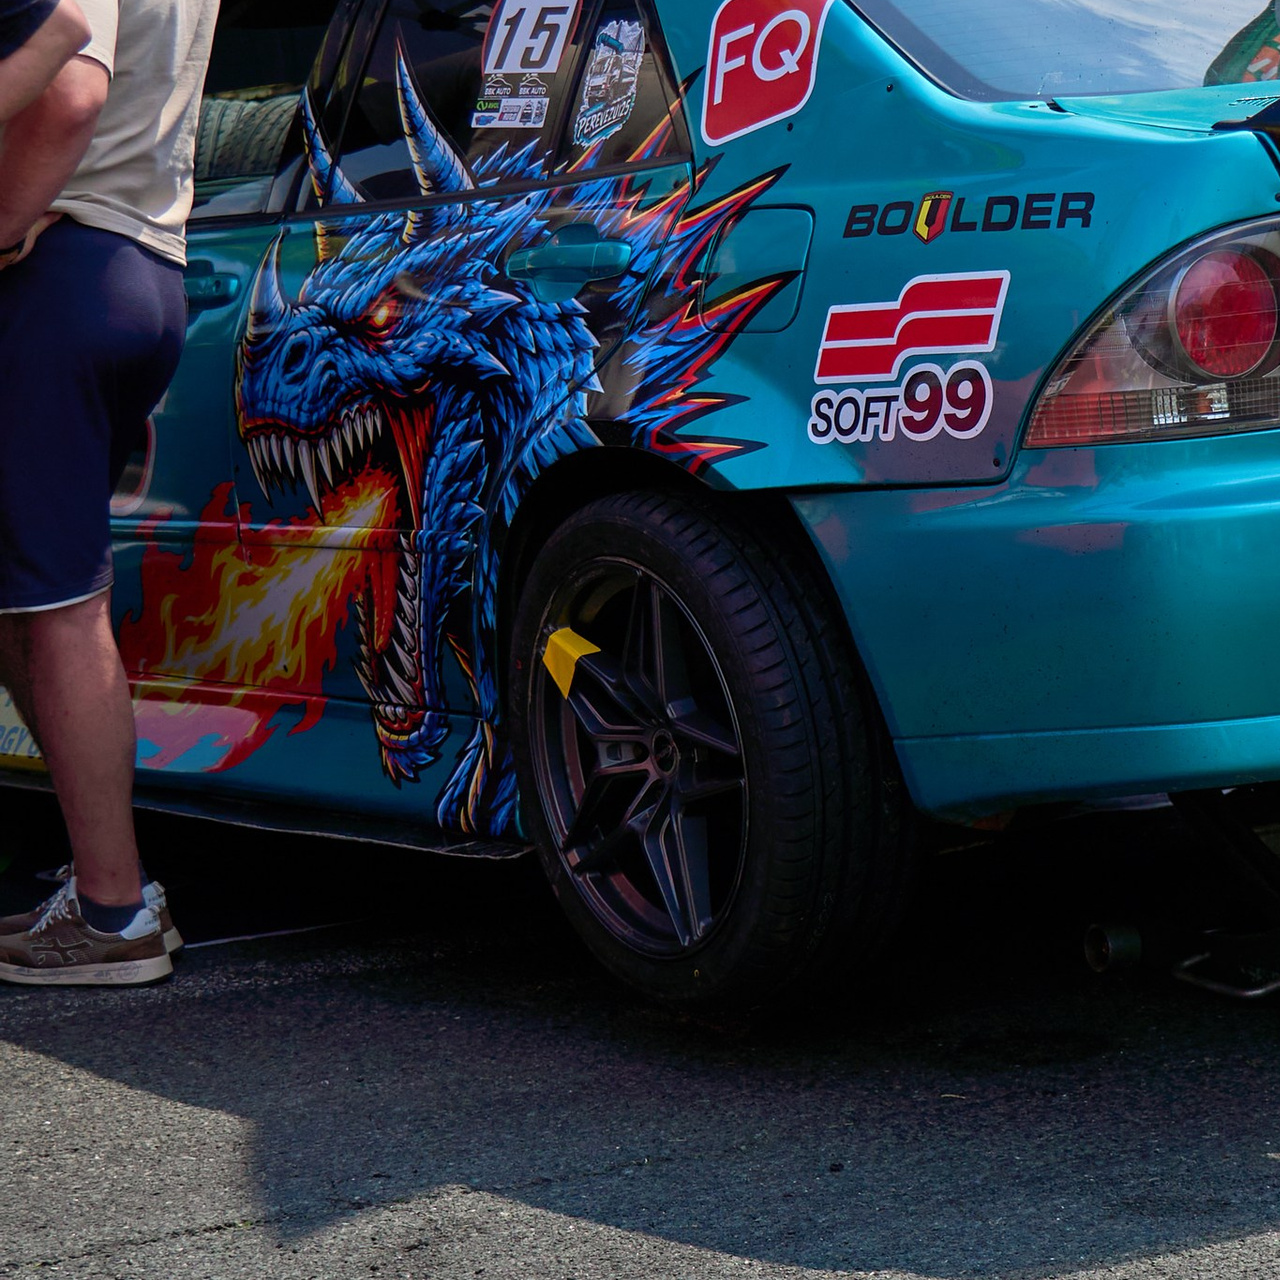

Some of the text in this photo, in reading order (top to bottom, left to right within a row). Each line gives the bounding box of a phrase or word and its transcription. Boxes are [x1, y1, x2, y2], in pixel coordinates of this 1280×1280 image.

[493, 6, 570, 70] 15
[713, 9, 811, 106] FQ
[843, 191, 1096, 240] BOULDER
